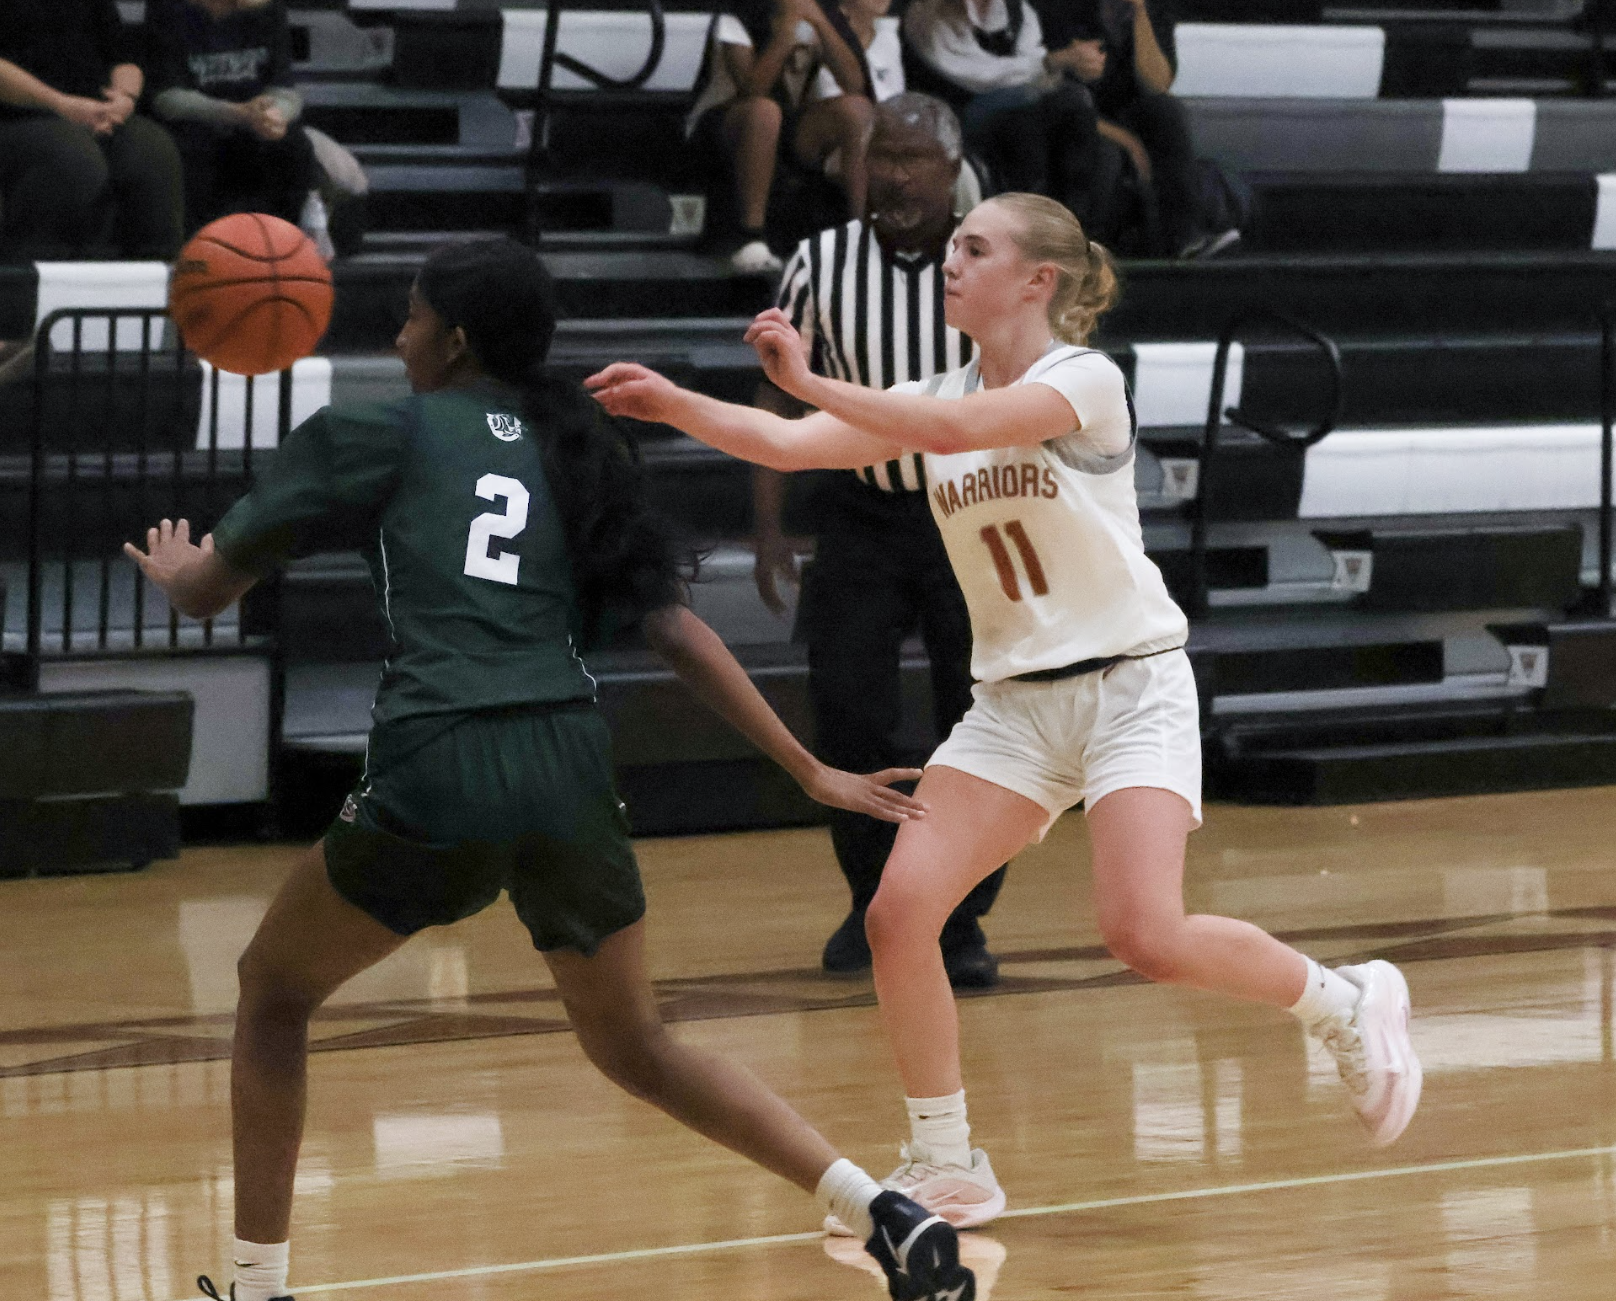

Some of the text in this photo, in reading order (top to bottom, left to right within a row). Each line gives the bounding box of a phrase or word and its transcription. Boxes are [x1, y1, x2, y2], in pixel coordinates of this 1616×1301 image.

[463, 473, 530, 586] 2
[933, 463, 1059, 519] WARRIORS
[979, 519, 1050, 603] 11
